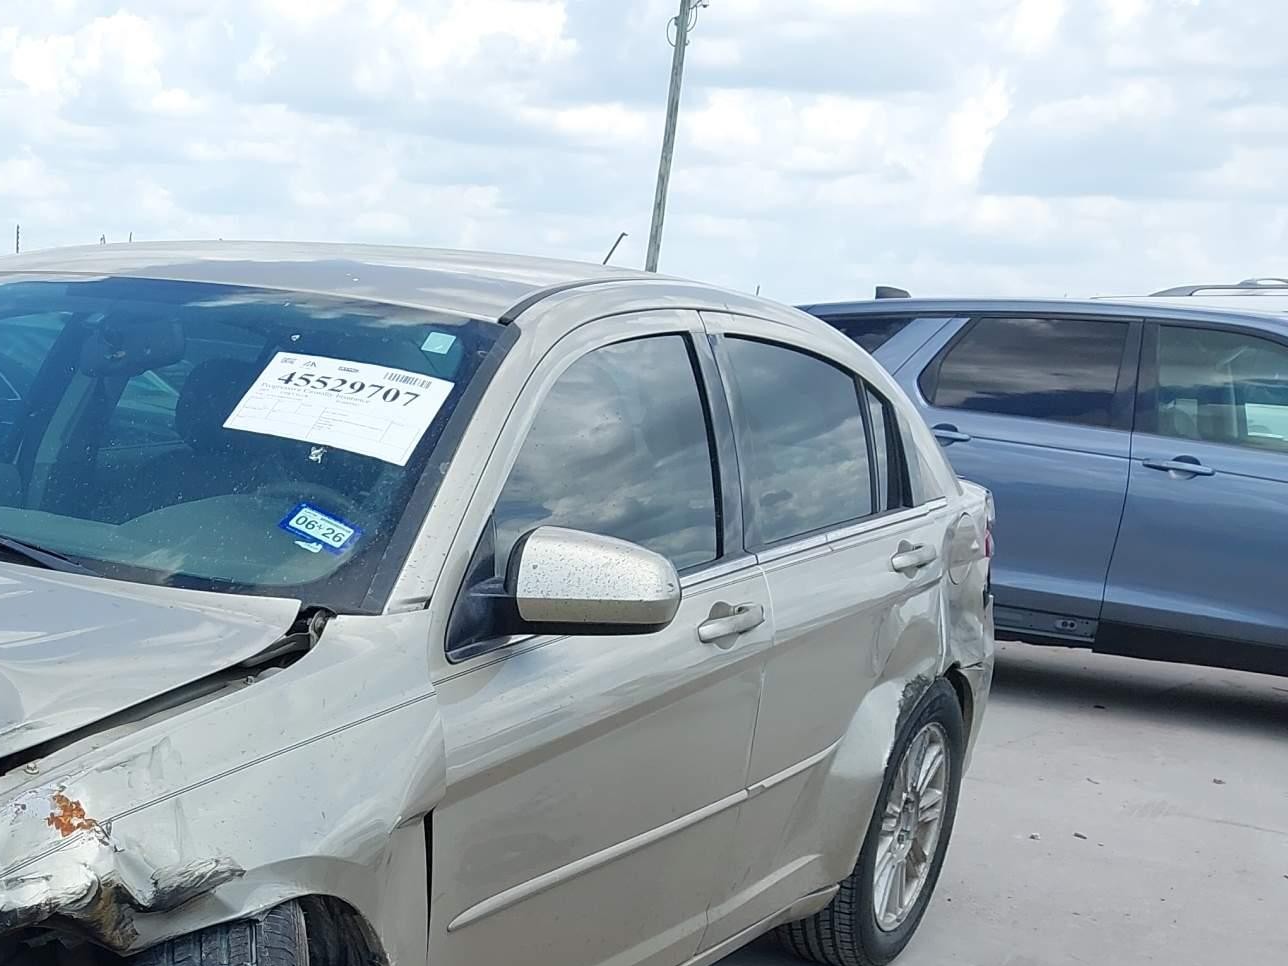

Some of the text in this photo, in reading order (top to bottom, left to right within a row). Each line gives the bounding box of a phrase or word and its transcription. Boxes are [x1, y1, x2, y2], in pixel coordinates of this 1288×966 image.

[278, 371, 421, 407] 45529707
[295, 514, 318, 531] 06
[321, 526, 345, 543] 26
